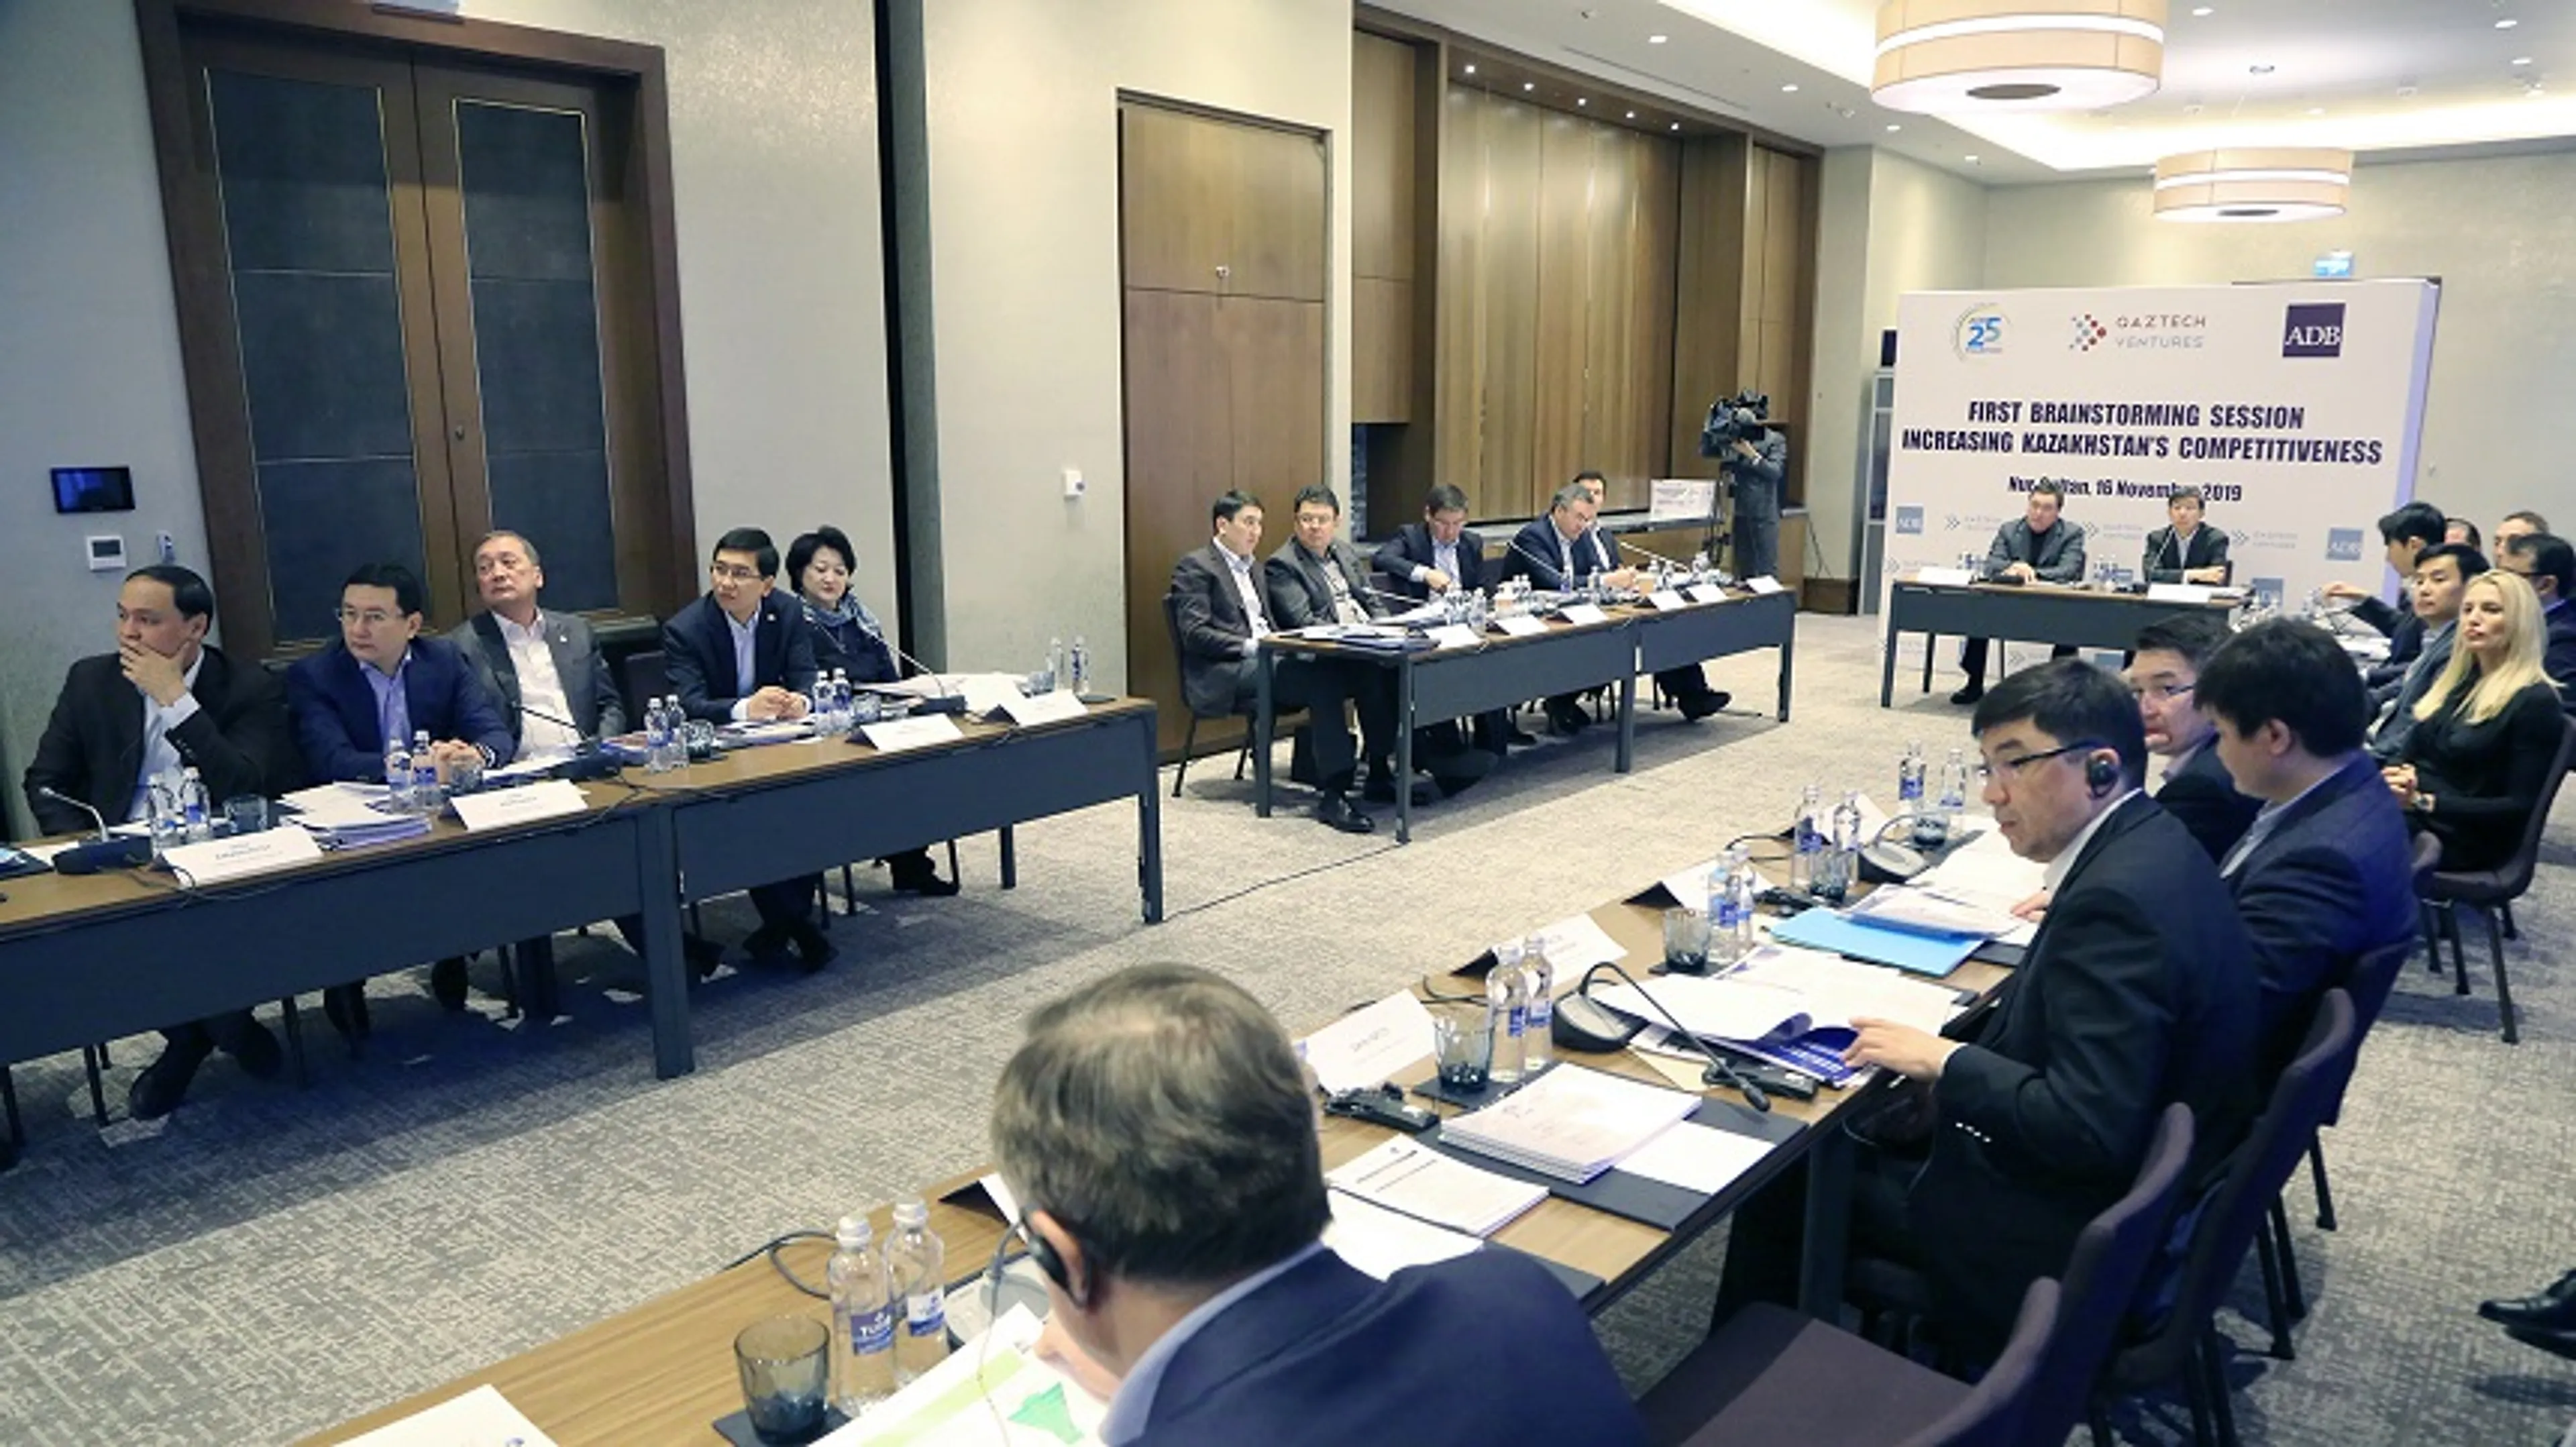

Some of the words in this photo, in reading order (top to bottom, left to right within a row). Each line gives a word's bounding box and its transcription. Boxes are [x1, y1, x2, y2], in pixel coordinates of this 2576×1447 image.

[1967, 317, 2003, 346] 25
[2115, 335, 2205, 348] VENTURES
[2285, 325, 2342, 345] ADB
[1968, 400, 2023, 423] FIRST
[2030, 403, 2200, 427] BRAINSTORMING
[2210, 404, 2304, 429] SESSION
[1901, 427, 2014, 453] INCREASING
[2021, 433, 2169, 458] KAZAKHSTAN'S
[2178, 437, 2383, 464] COMPETITIVENESS
[2096, 480, 2112, 495] 16
[2202, 484, 2242, 502] 2019
